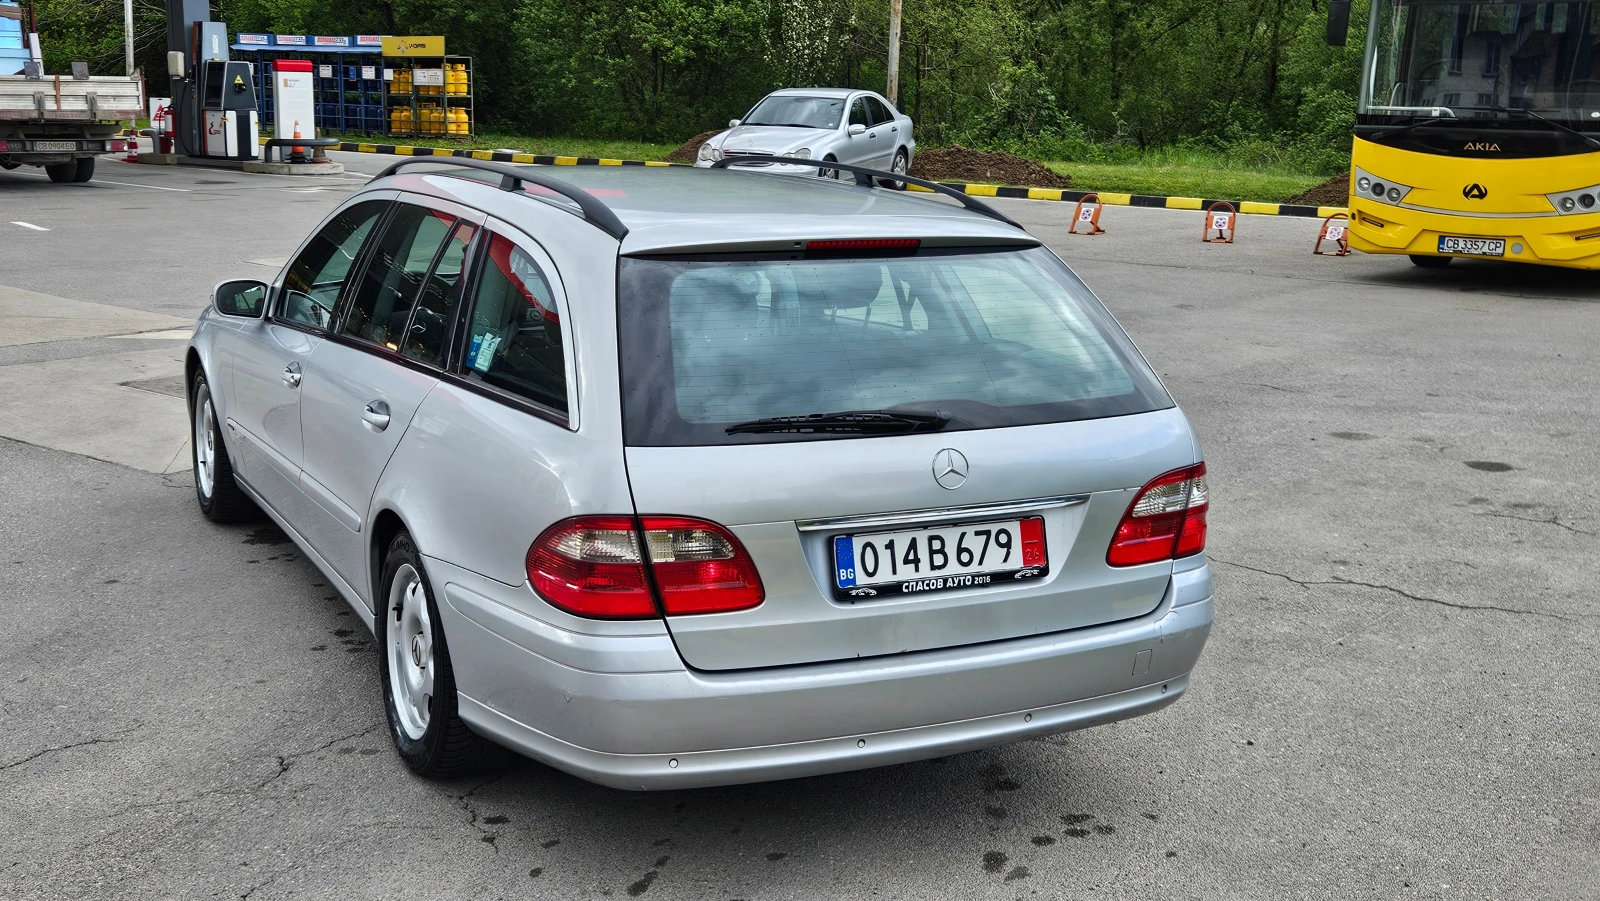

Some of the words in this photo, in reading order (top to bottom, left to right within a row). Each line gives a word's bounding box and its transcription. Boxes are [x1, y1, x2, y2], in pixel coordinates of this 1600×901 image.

[38, 142, 47, 150] CB
[48, 142, 64, 150] 0904
[1464, 142, 1501, 152] AKIA
[1446, 238, 1459, 249] CB
[1461, 239, 1486, 251] 3357
[1488, 241, 1502, 252] CP
[840, 568, 854, 581] BG
[902, 578, 943, 593] СПАСОВ
[946, 575, 972, 589] АУТО
[974, 575, 991, 584] 2016
